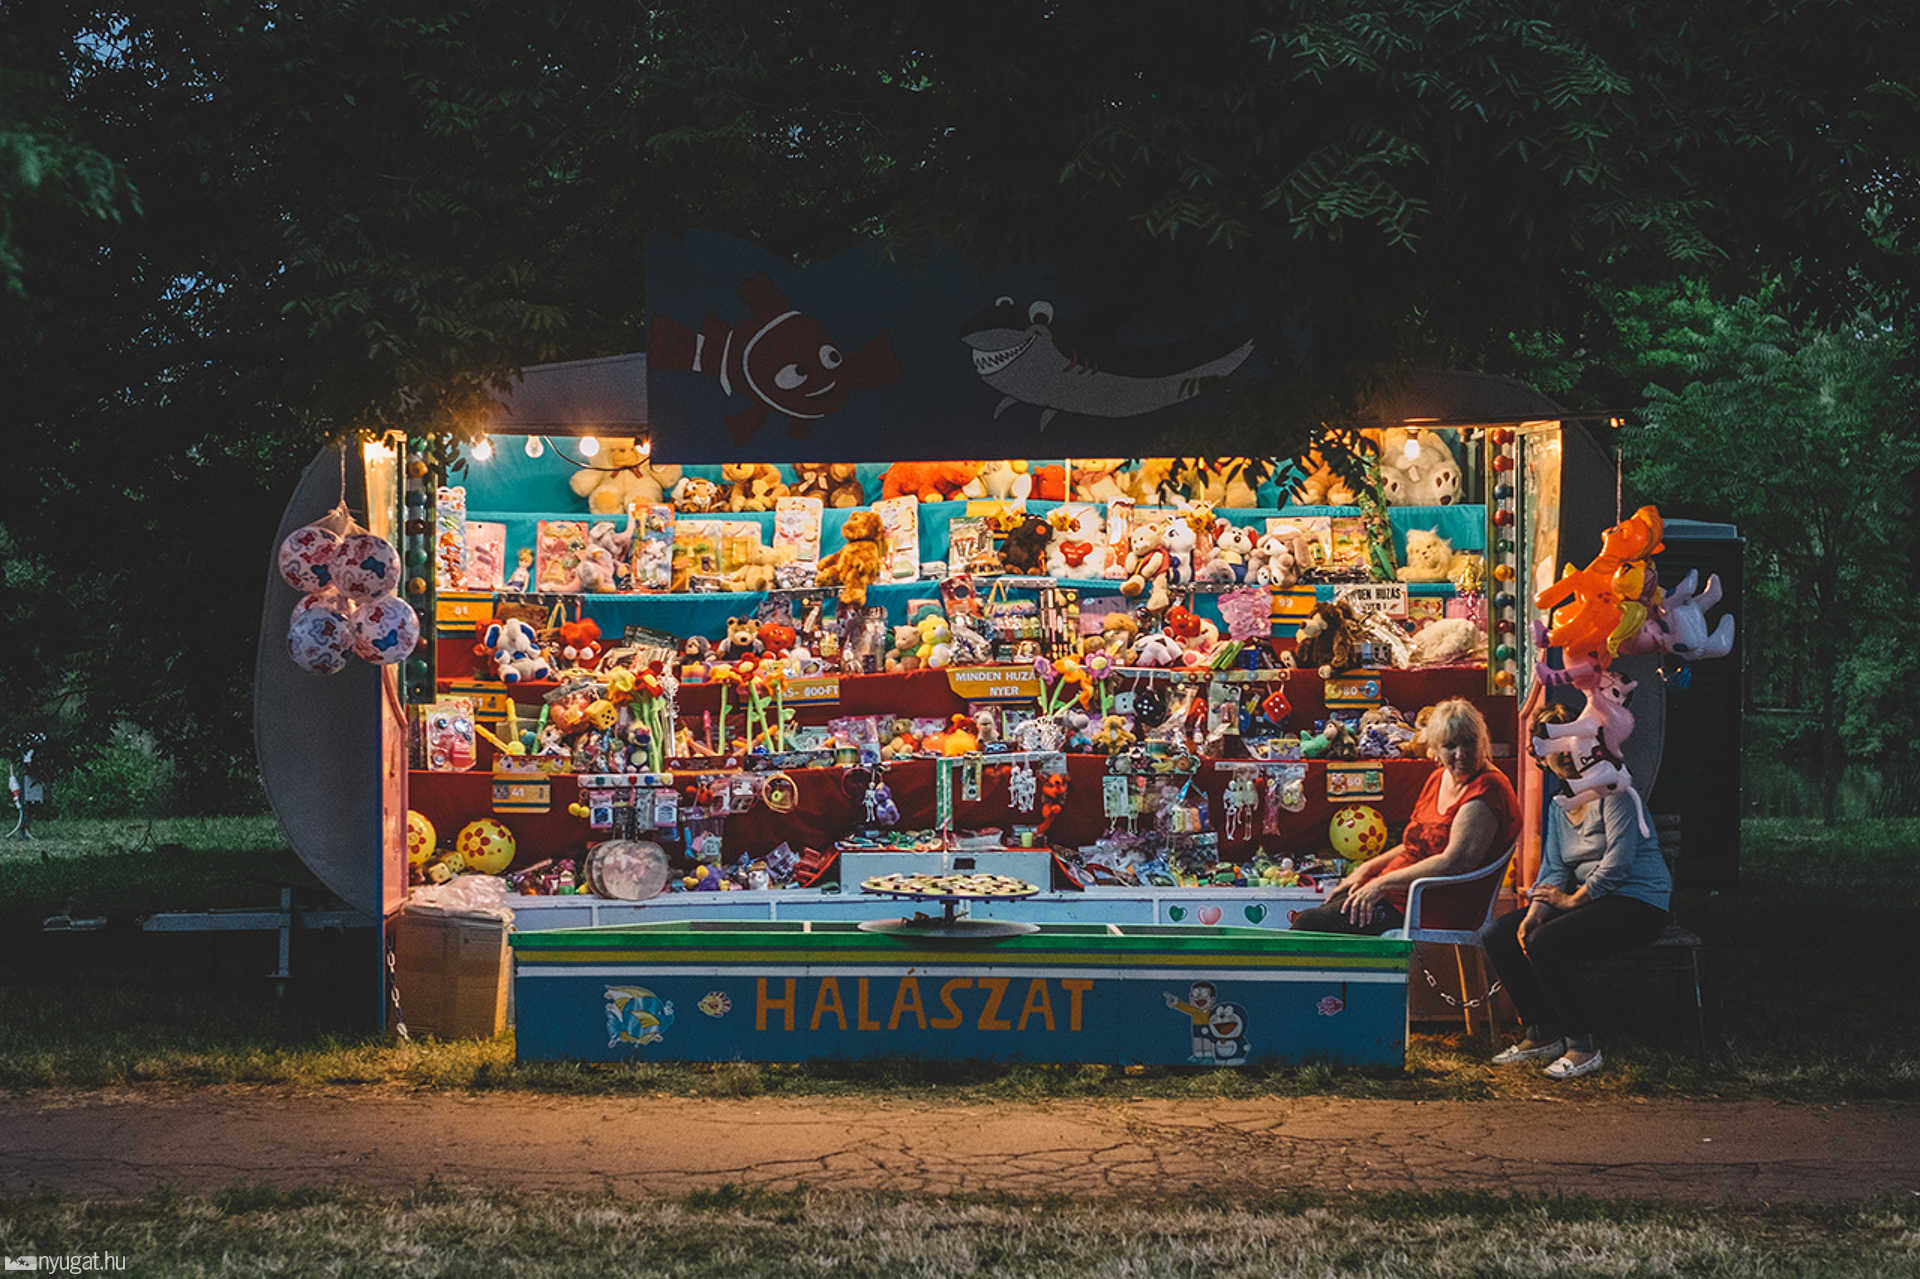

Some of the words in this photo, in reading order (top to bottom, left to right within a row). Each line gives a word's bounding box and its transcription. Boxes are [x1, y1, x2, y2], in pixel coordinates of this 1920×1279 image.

[955, 671, 1002, 682] MINDEN
[1005, 671, 1036, 681] HUZA
[989, 685, 1020, 697] NYER
[511, 787, 525, 798] 41
[755, 967, 1095, 1032] HALÁSZAT
